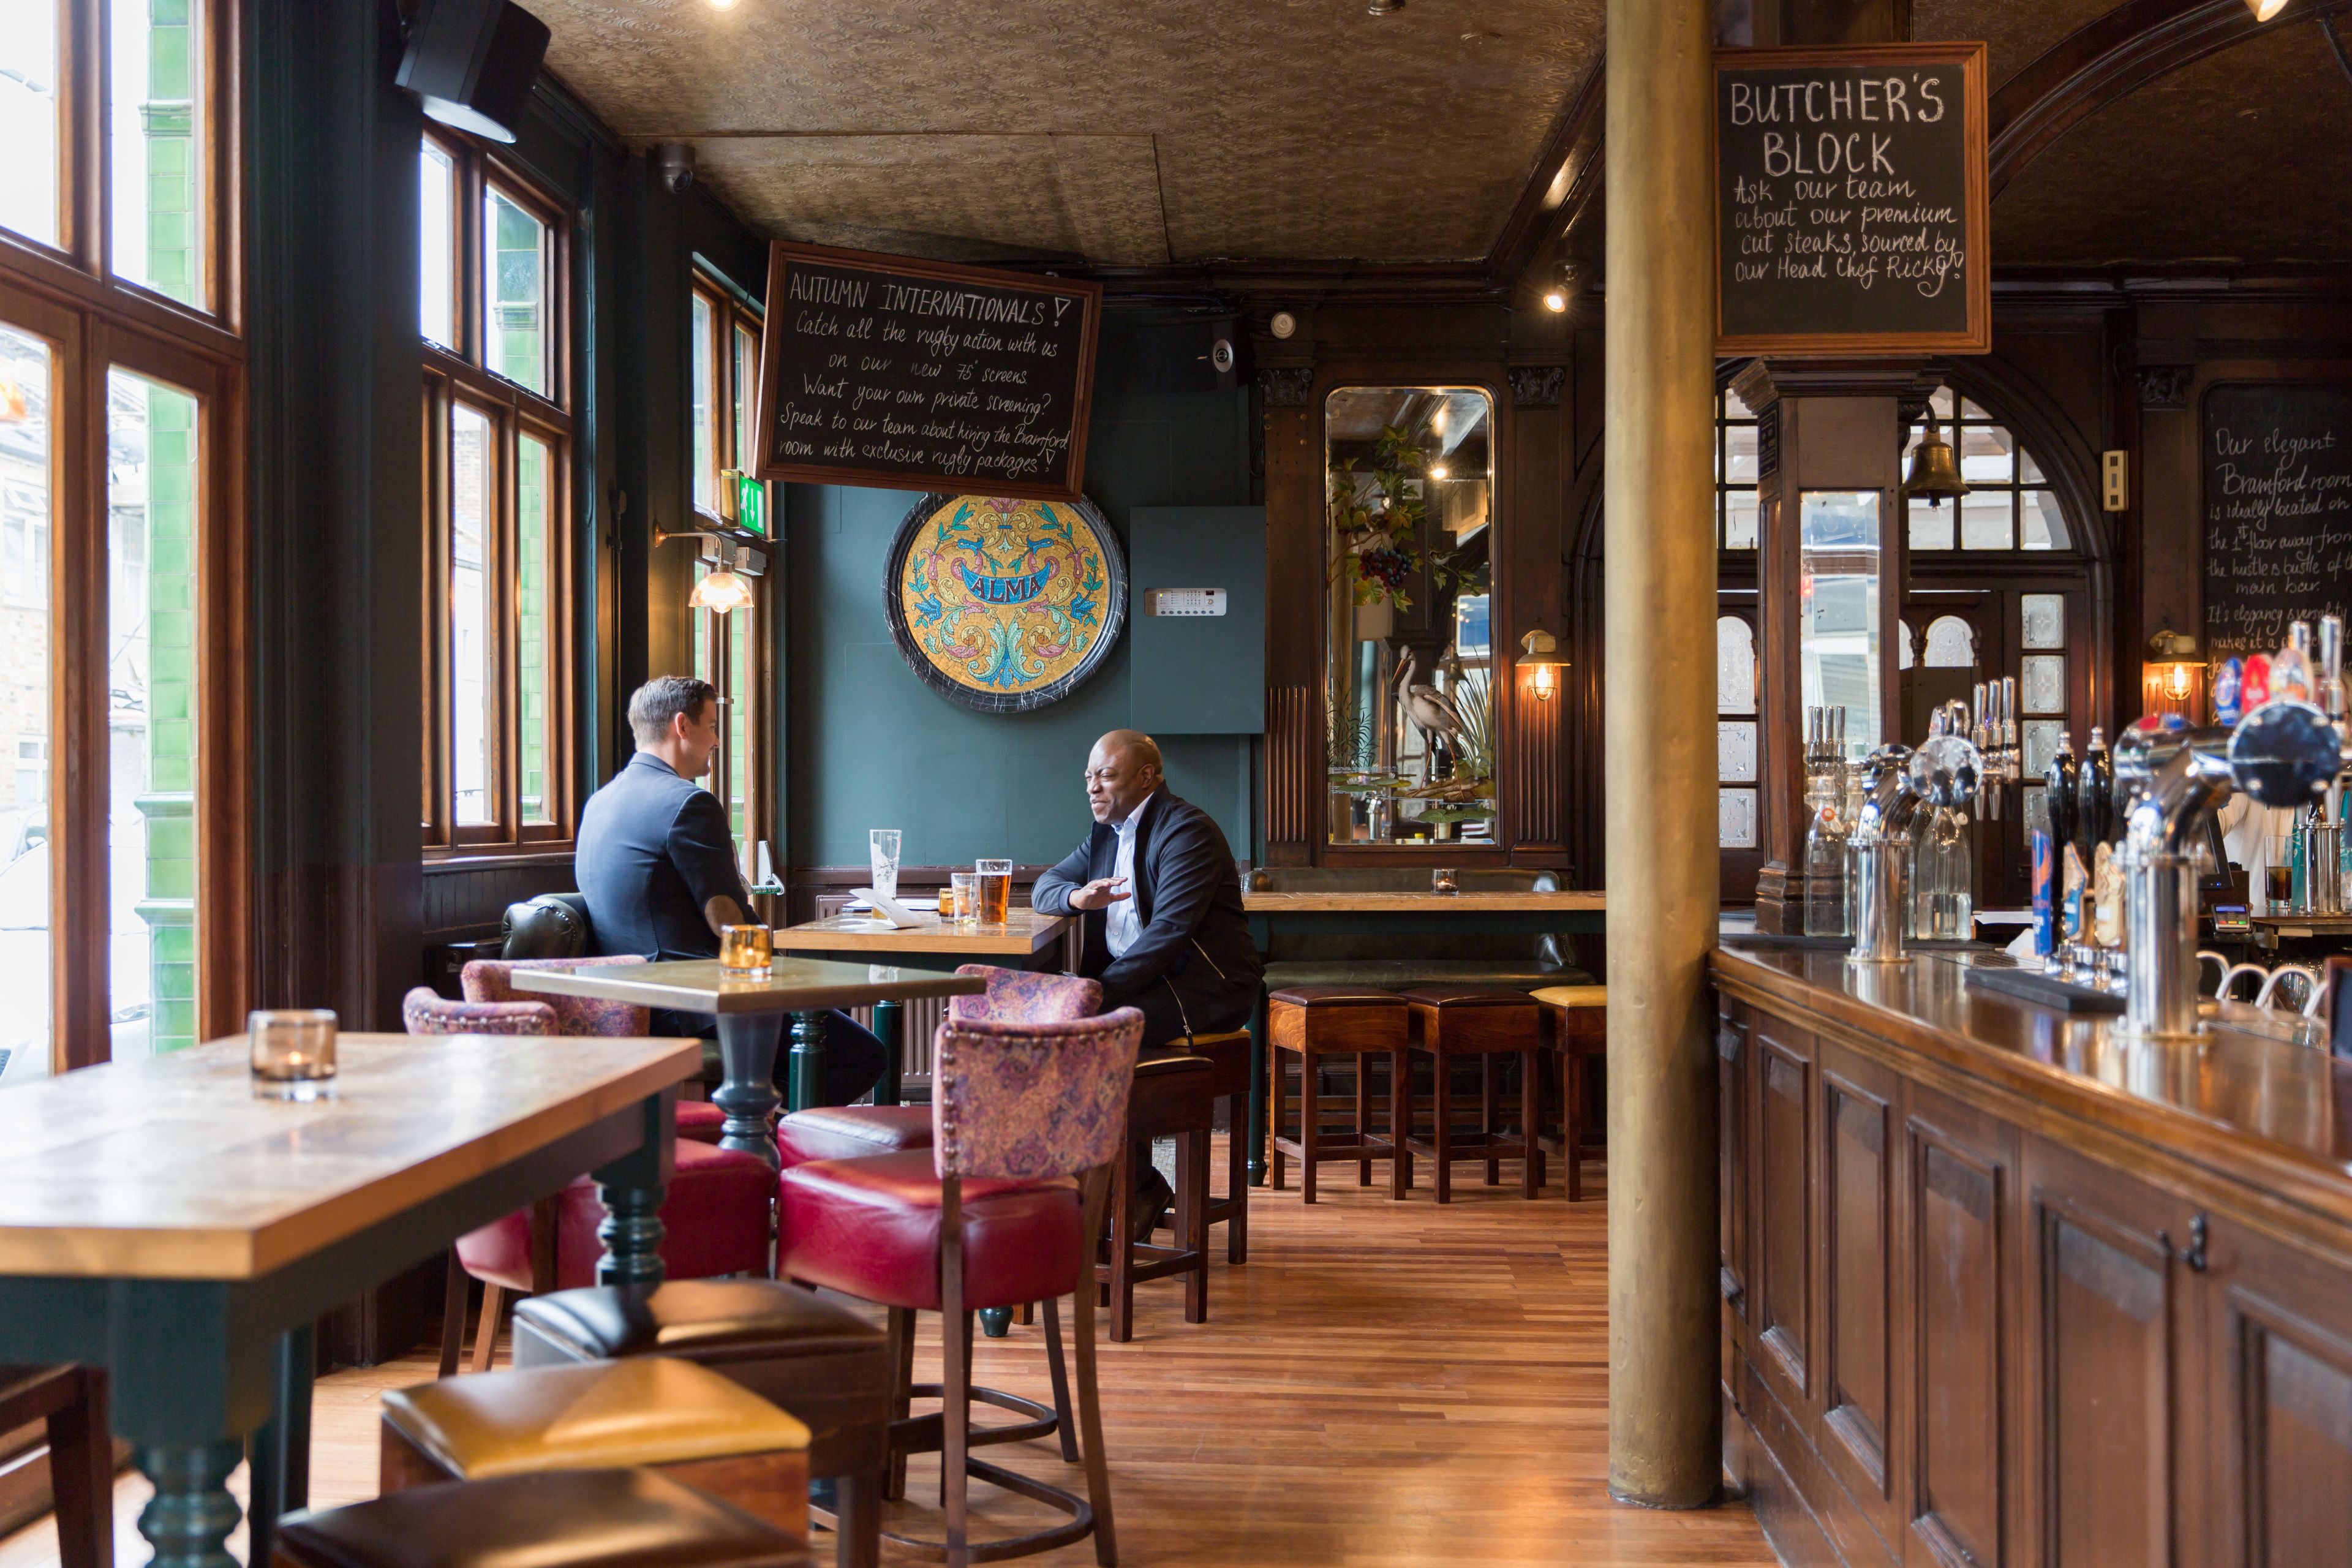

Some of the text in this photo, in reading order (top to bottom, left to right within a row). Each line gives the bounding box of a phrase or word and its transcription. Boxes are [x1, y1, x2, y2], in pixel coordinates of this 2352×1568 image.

[1731, 73, 1945, 125] BUTCHER'S
[1764, 132, 1894, 177] BLOCK
[1734, 174, 1917, 204] Ask our team
[1735, 200, 1958, 232] about our premium
[1741, 230, 1773, 254] cut
[1861, 228, 1929, 252] sourced
[1934, 230, 1956, 265] by
[1735, 260, 1769, 282] our
[1777, 256, 1827, 280] Head
[1837, 254, 1877, 290] Chef
[790, 273, 869, 308] AUTUMN
[797, 311, 1057, 357] Catch all the rugby action with us
[829, 353, 848, 368] on
[862, 356, 890, 370] our
[911, 363, 941, 377] new
[804, 374, 1051, 424] Want your own private screening?
[781, 402, 1071, 457] Speak to our team about hiring the Bramford
[780, 440, 813, 456] room
[824, 436, 855, 458] with
[862, 444, 924, 464] exclusive
[932, 445, 971, 475] rugby
[2216, 428, 2336, 470] Our elegant
[2215, 462, 2307, 510] Bramford
[2209, 492, 2351, 531] is ideally located on
[2207, 527, 2227, 549] the
[2245, 530, 2277, 558] floor
[2279, 535, 2312, 561] away
[2207, 558, 2226, 577] the
[2232, 556, 2268, 576] hustle
[2283, 554, 2320, 575] bustle
[2328, 552, 2342, 582] of
[971, 576, 1041, 602] ALMA
[2236, 580, 2277, 595] main
[2206, 601, 2229, 624] It's
[2234, 604, 2283, 636] elegancy
[2211, 631, 2246, 650] makes
[2250, 627, 2263, 649] it
[2268, 638, 2278, 649] a
